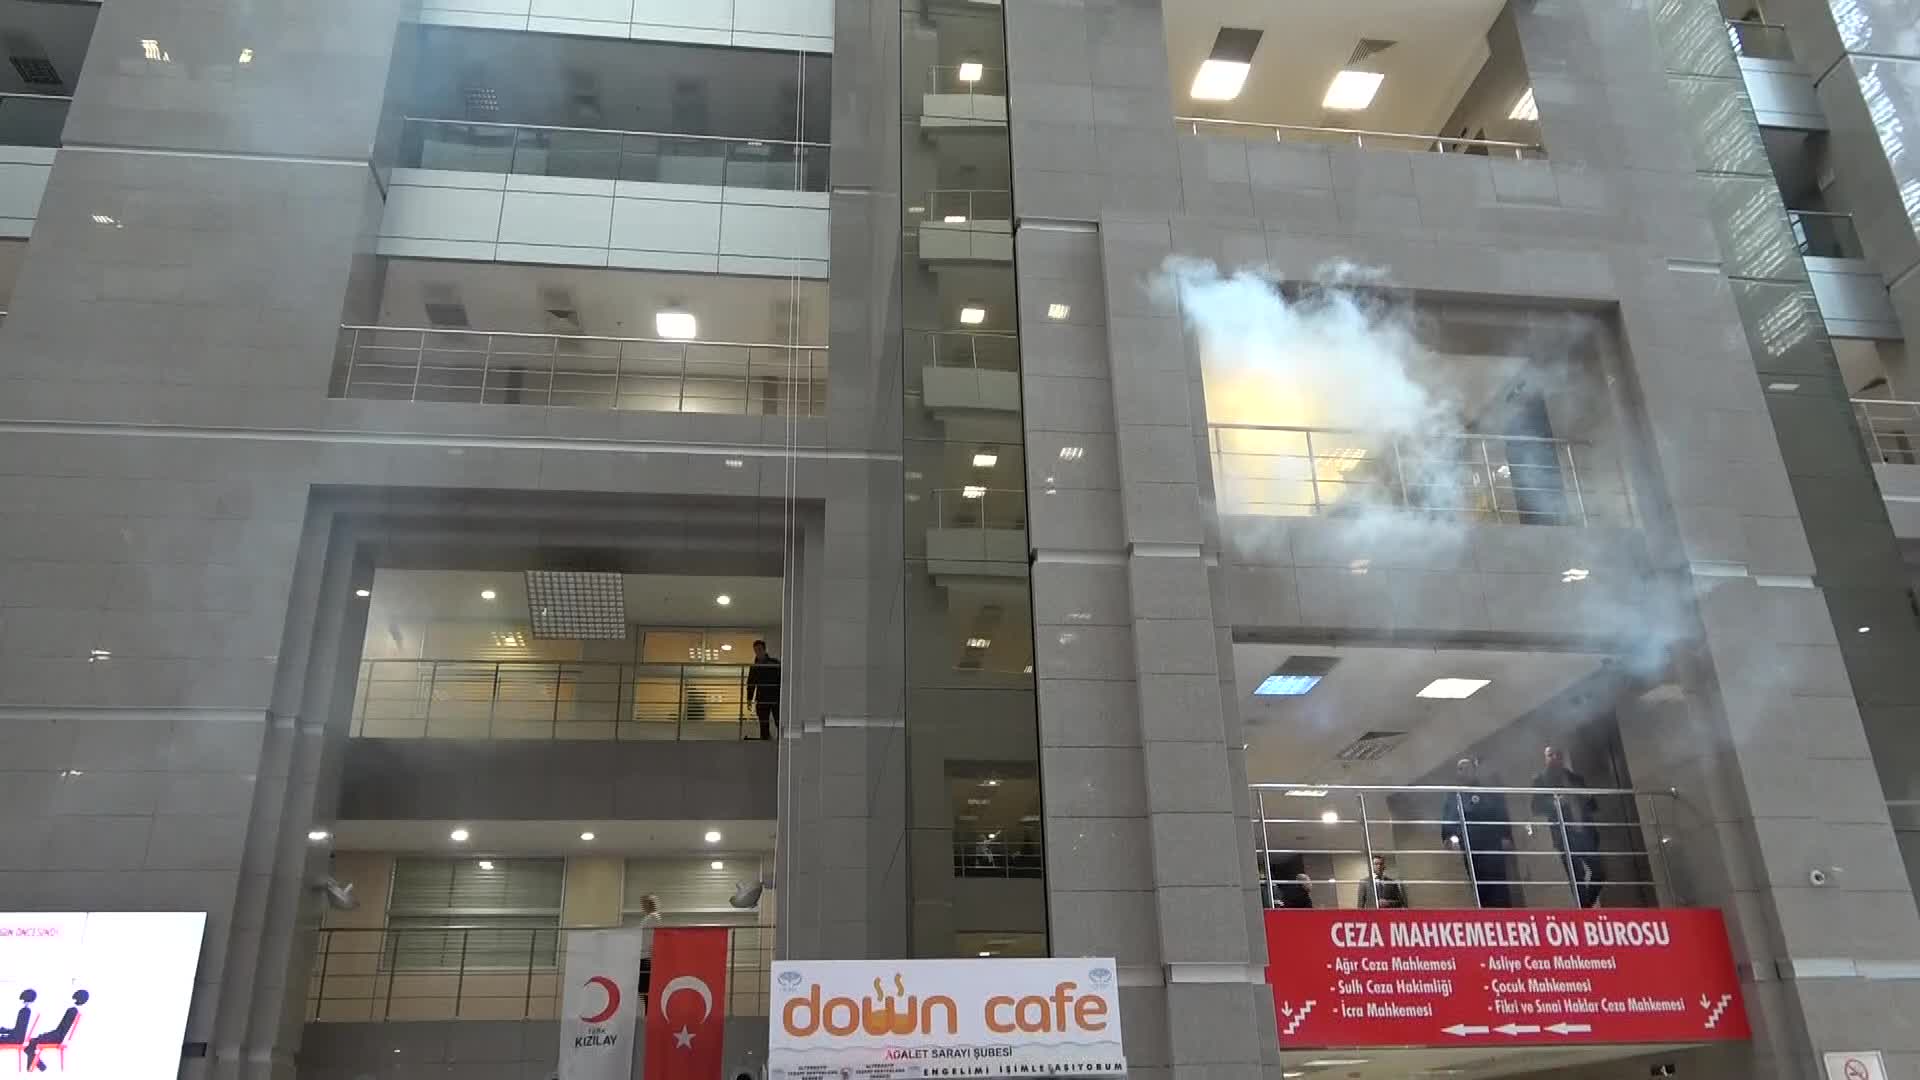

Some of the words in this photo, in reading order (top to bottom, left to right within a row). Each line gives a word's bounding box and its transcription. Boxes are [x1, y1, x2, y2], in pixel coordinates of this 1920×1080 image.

[1331, 921, 1385, 947] CEZA
[1390, 916, 1541, 947] MAHKEMELERİ
[1546, 915, 1579, 946] ÖN
[1583, 915, 1671, 946] BÜROSU
[1335, 957, 1358, 974] Ağır
[1361, 957, 1389, 971] Ceza
[1392, 956, 1457, 971] Mahkemesi
[1488, 955, 1521, 973] Asliye
[1524, 956, 1551, 970] Ceza
[1553, 955, 1617, 970] Mahkemesi
[1338, 979, 1363, 995] Sulh
[1366, 979, 1393, 994] Ceza
[1396, 978, 1453, 997] Hakimliği
[1491, 979, 1526, 997] Çocuk
[1528, 978, 1593, 993] Mahkemesi
[783, 983, 958, 1037] down
[984, 981, 1108, 1033] cafe
[1341, 1000, 1364, 1018] İcra
[1367, 1001, 1433, 1018] Mahkemesi
[1495, 999, 1519, 1014] Fikri
[1521, 1003, 1533, 1014] ve
[1564, 998, 1600, 1013] Haklar
[1601, 998, 1626, 1012] Ceza
[1628, 997, 1686, 1012] Mahkemesi
[575, 1034, 618, 1048] KIZILAY
[885, 1049, 929, 1060] ADALET
[931, 1048, 971, 1058] SARAYI
[973, 1046, 1013, 1060] ŞUBESİ
